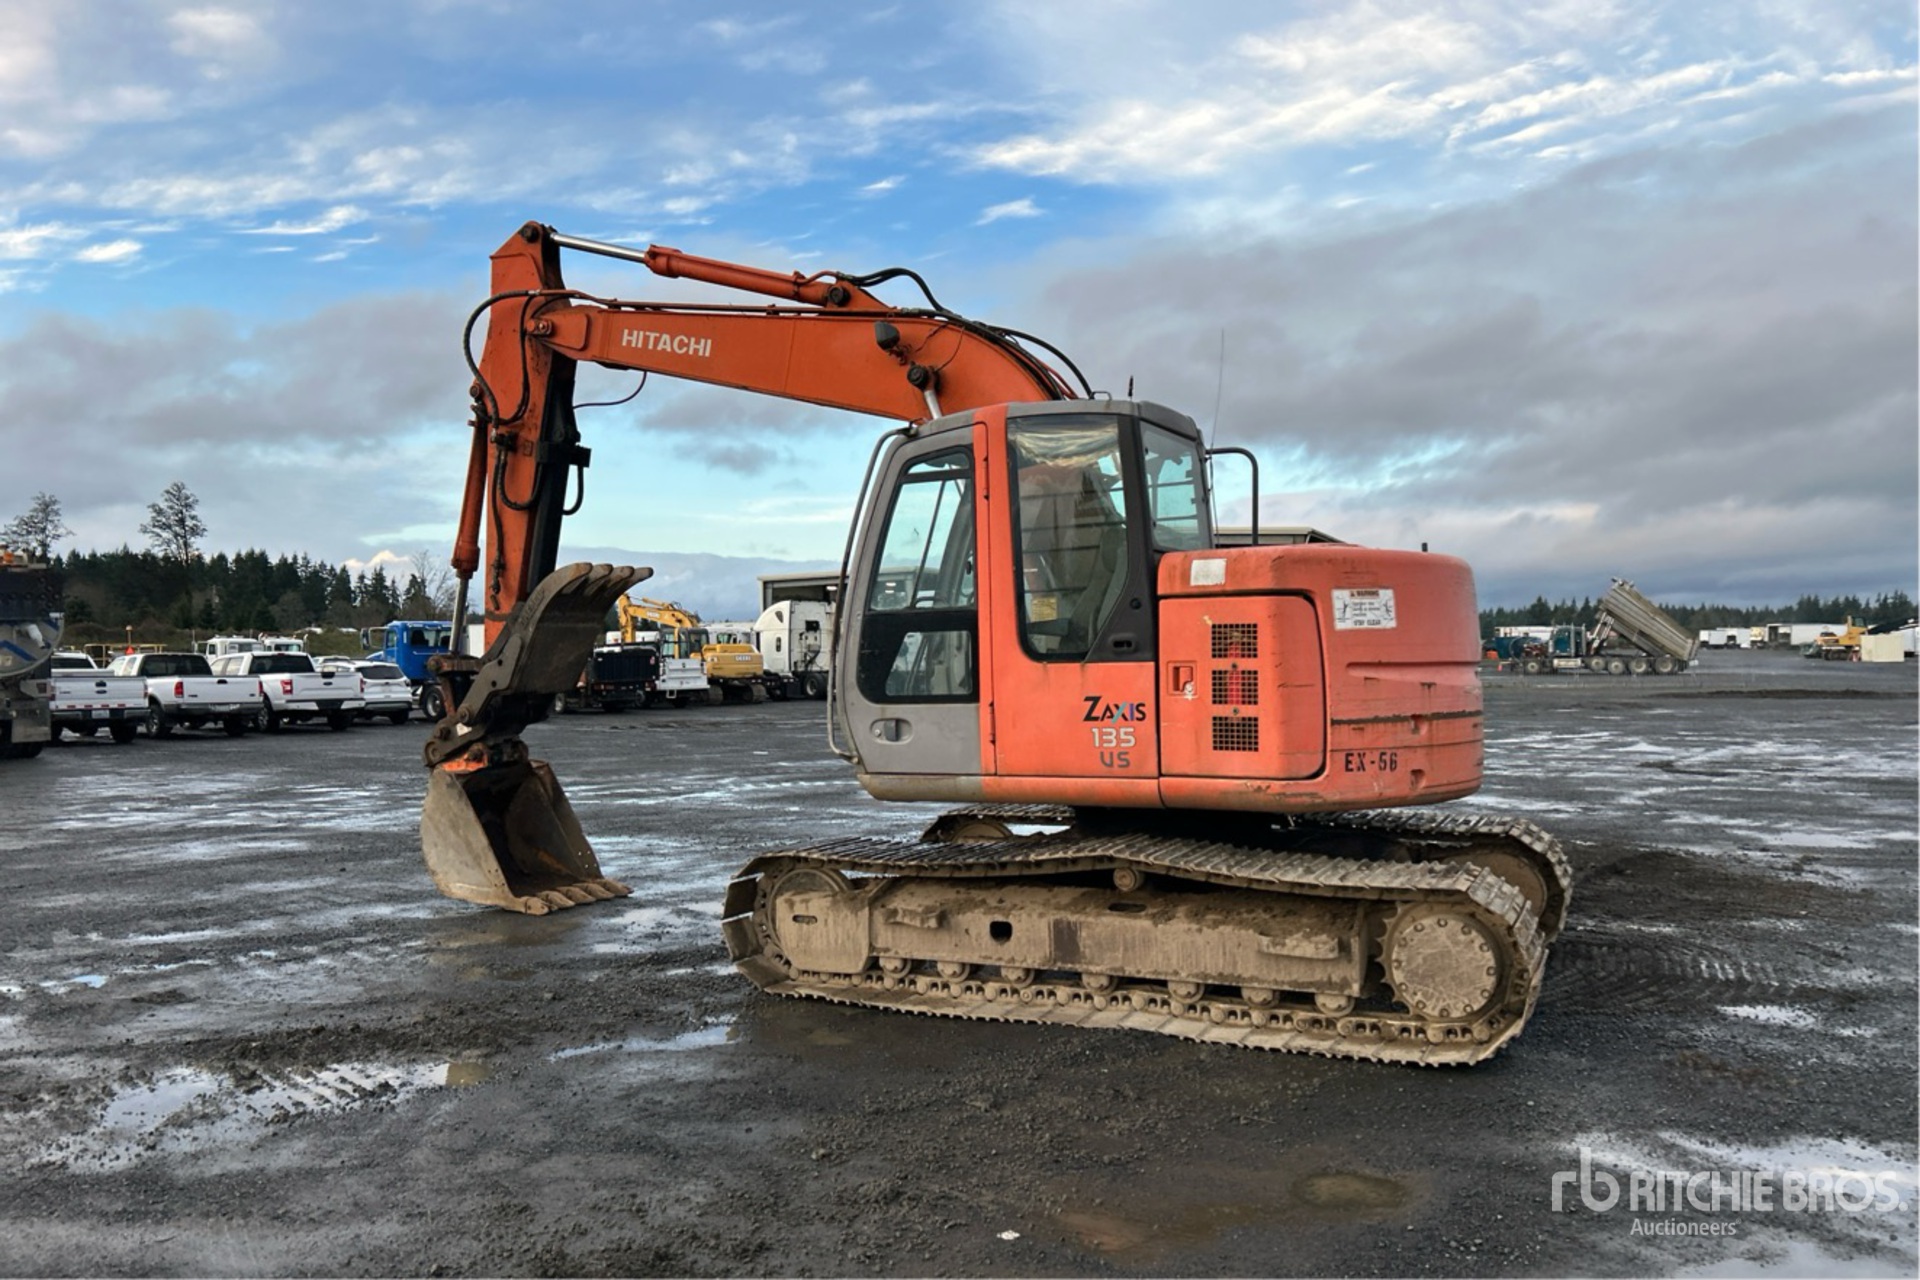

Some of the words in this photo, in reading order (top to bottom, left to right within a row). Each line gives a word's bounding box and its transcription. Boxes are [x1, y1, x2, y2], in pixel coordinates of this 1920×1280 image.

[622, 328, 712, 357] HITACHI
[1083, 696, 1147, 724] ZAXIS
[1091, 727, 1136, 748] 135
[1100, 751, 1131, 768] US
[1345, 751, 1398, 772] EX-56
